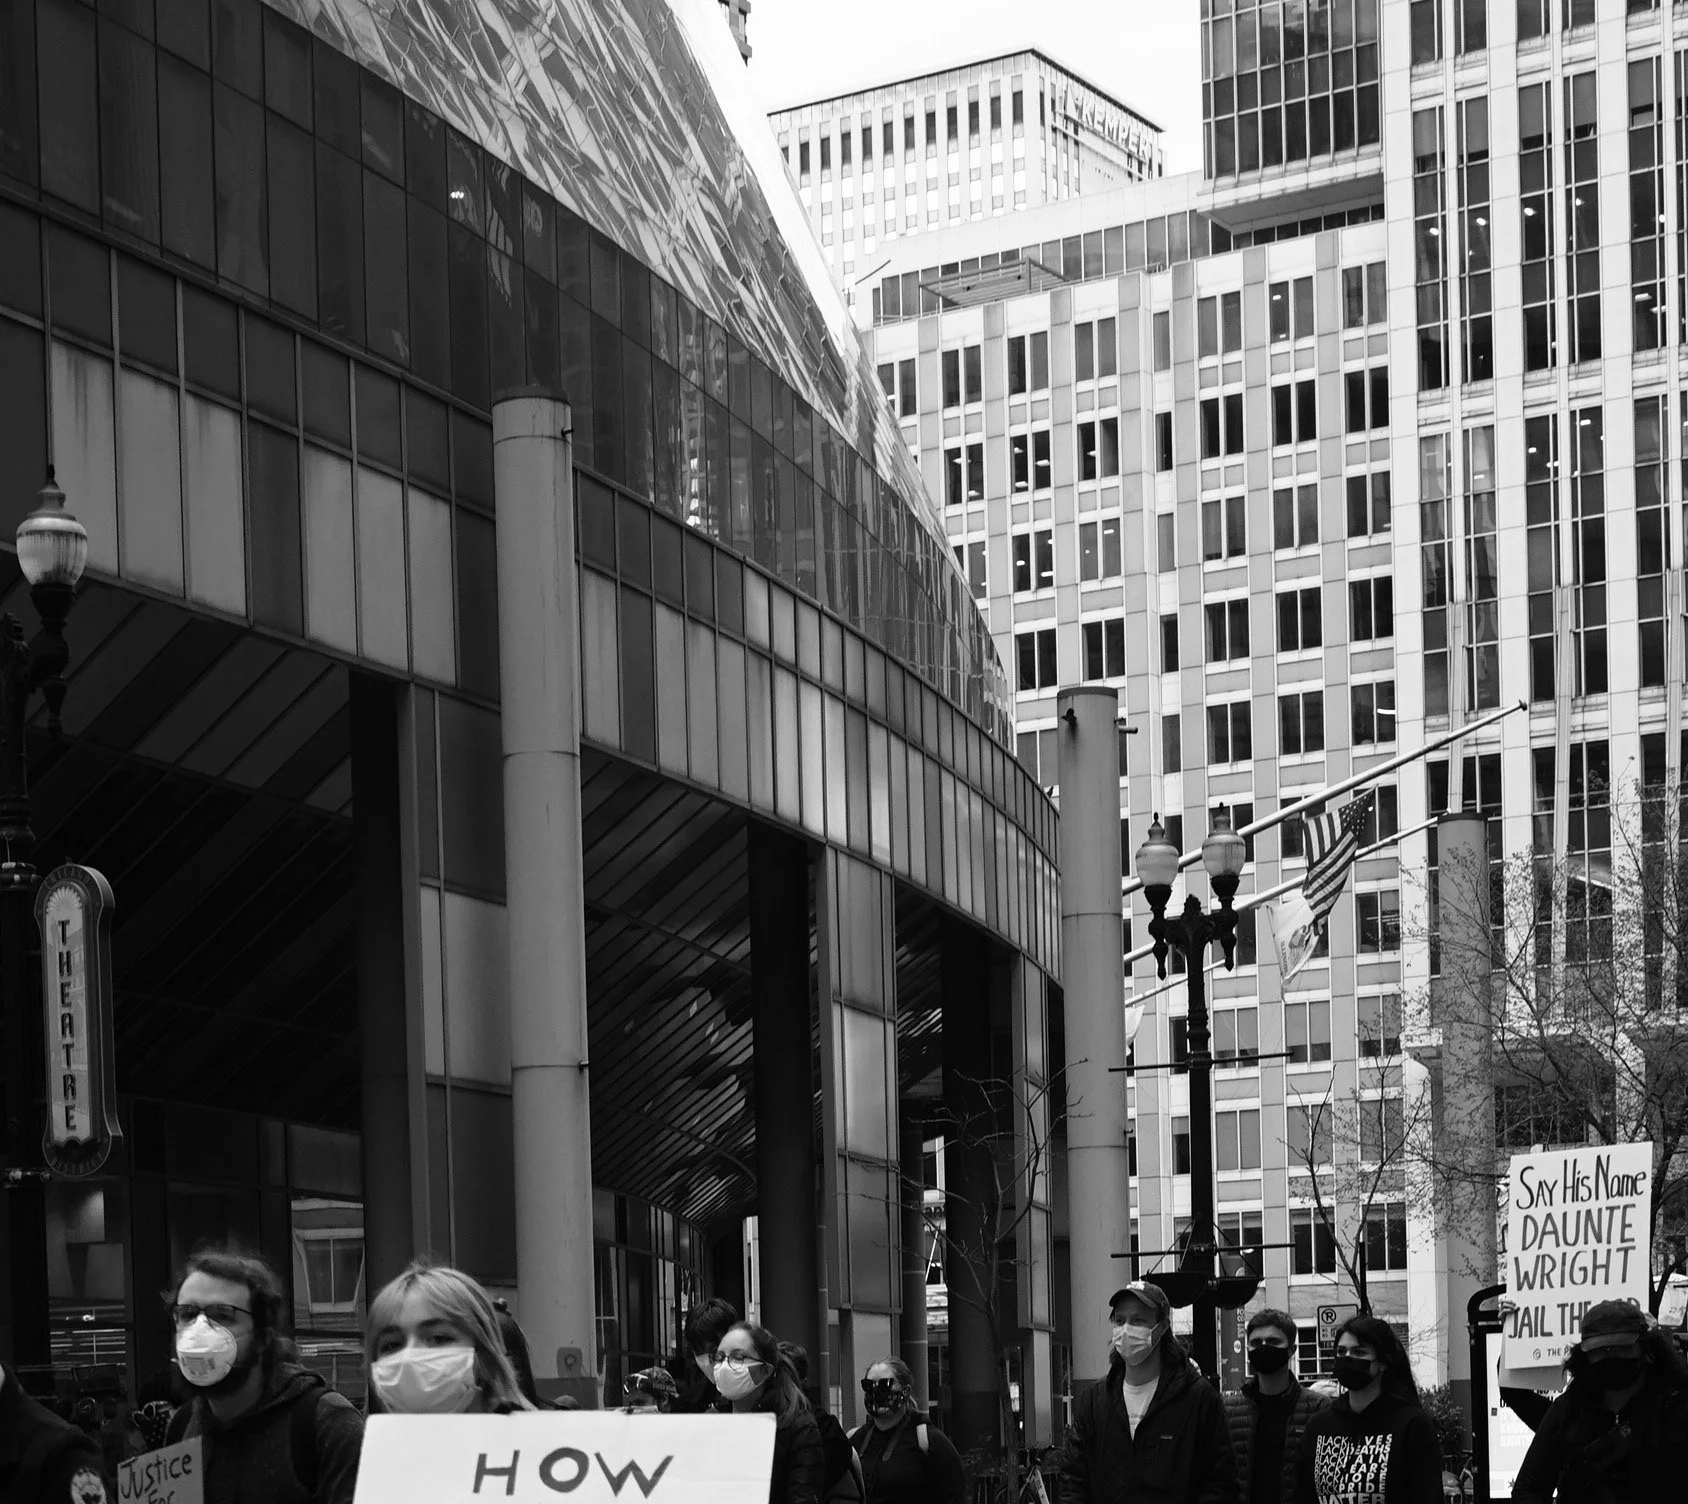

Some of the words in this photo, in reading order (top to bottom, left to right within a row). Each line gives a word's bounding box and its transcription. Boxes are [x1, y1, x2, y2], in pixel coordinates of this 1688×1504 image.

[1082, 96, 1150, 161] KEMPER
[57, 919, 77, 1131] THEATRE
[1522, 1203, 1637, 1251] DAUNTE
[1514, 1245, 1636, 1292] WRIGHT
[1508, 1304, 1554, 1340] JAIL
[1317, 1434, 1349, 1446] BLACK
[473, 1447, 674, 1498] HOW
[1339, 1482, 1386, 1494] PRIDE
[1349, 1462, 1389, 1474] EARS
